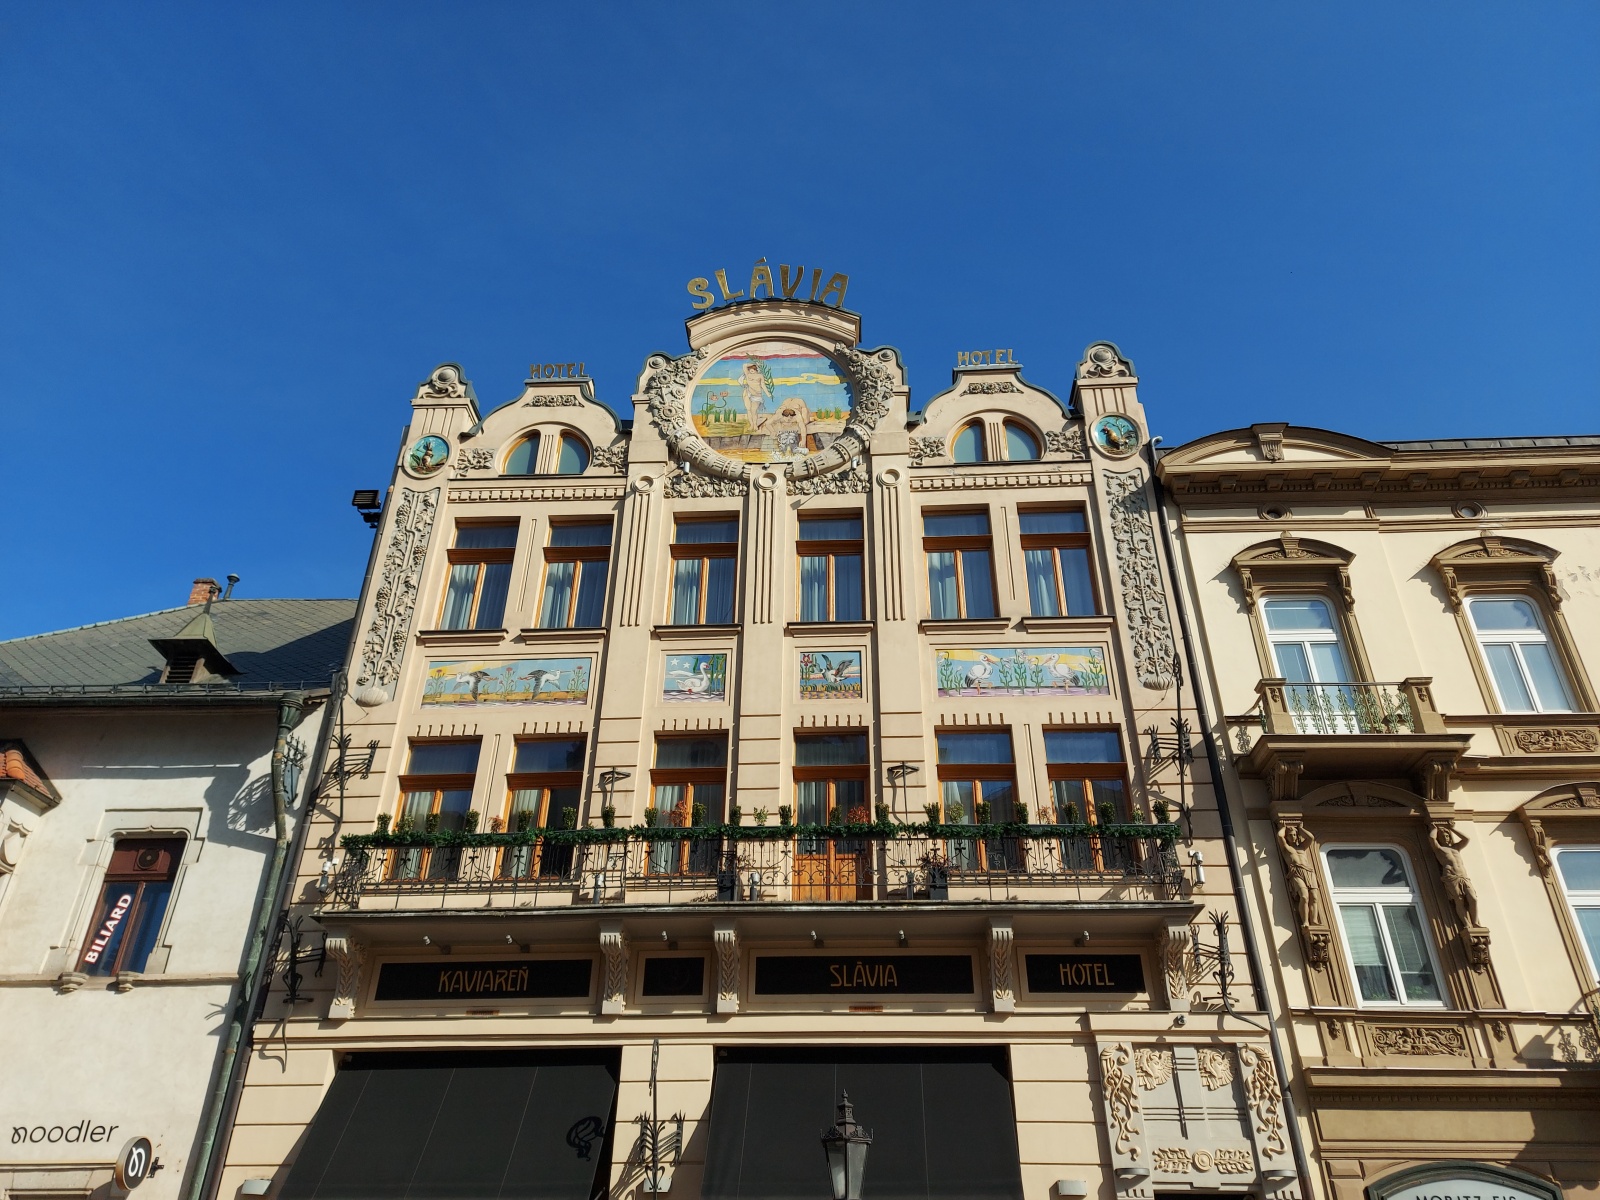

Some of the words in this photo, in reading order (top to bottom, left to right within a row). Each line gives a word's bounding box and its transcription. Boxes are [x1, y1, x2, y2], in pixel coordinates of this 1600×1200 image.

[687, 256, 849, 310] SLÁVIA
[957, 348, 1018, 366] HOTEL
[529, 362, 589, 379] HOTEL
[85, 894, 132, 964] BILIARD
[438, 966, 529, 993] KAVIAREŇ
[829, 961, 898, 987] SLÁVIA
[1059, 963, 1115, 986] HOTEL
[11, 1119, 119, 1144] noodler
